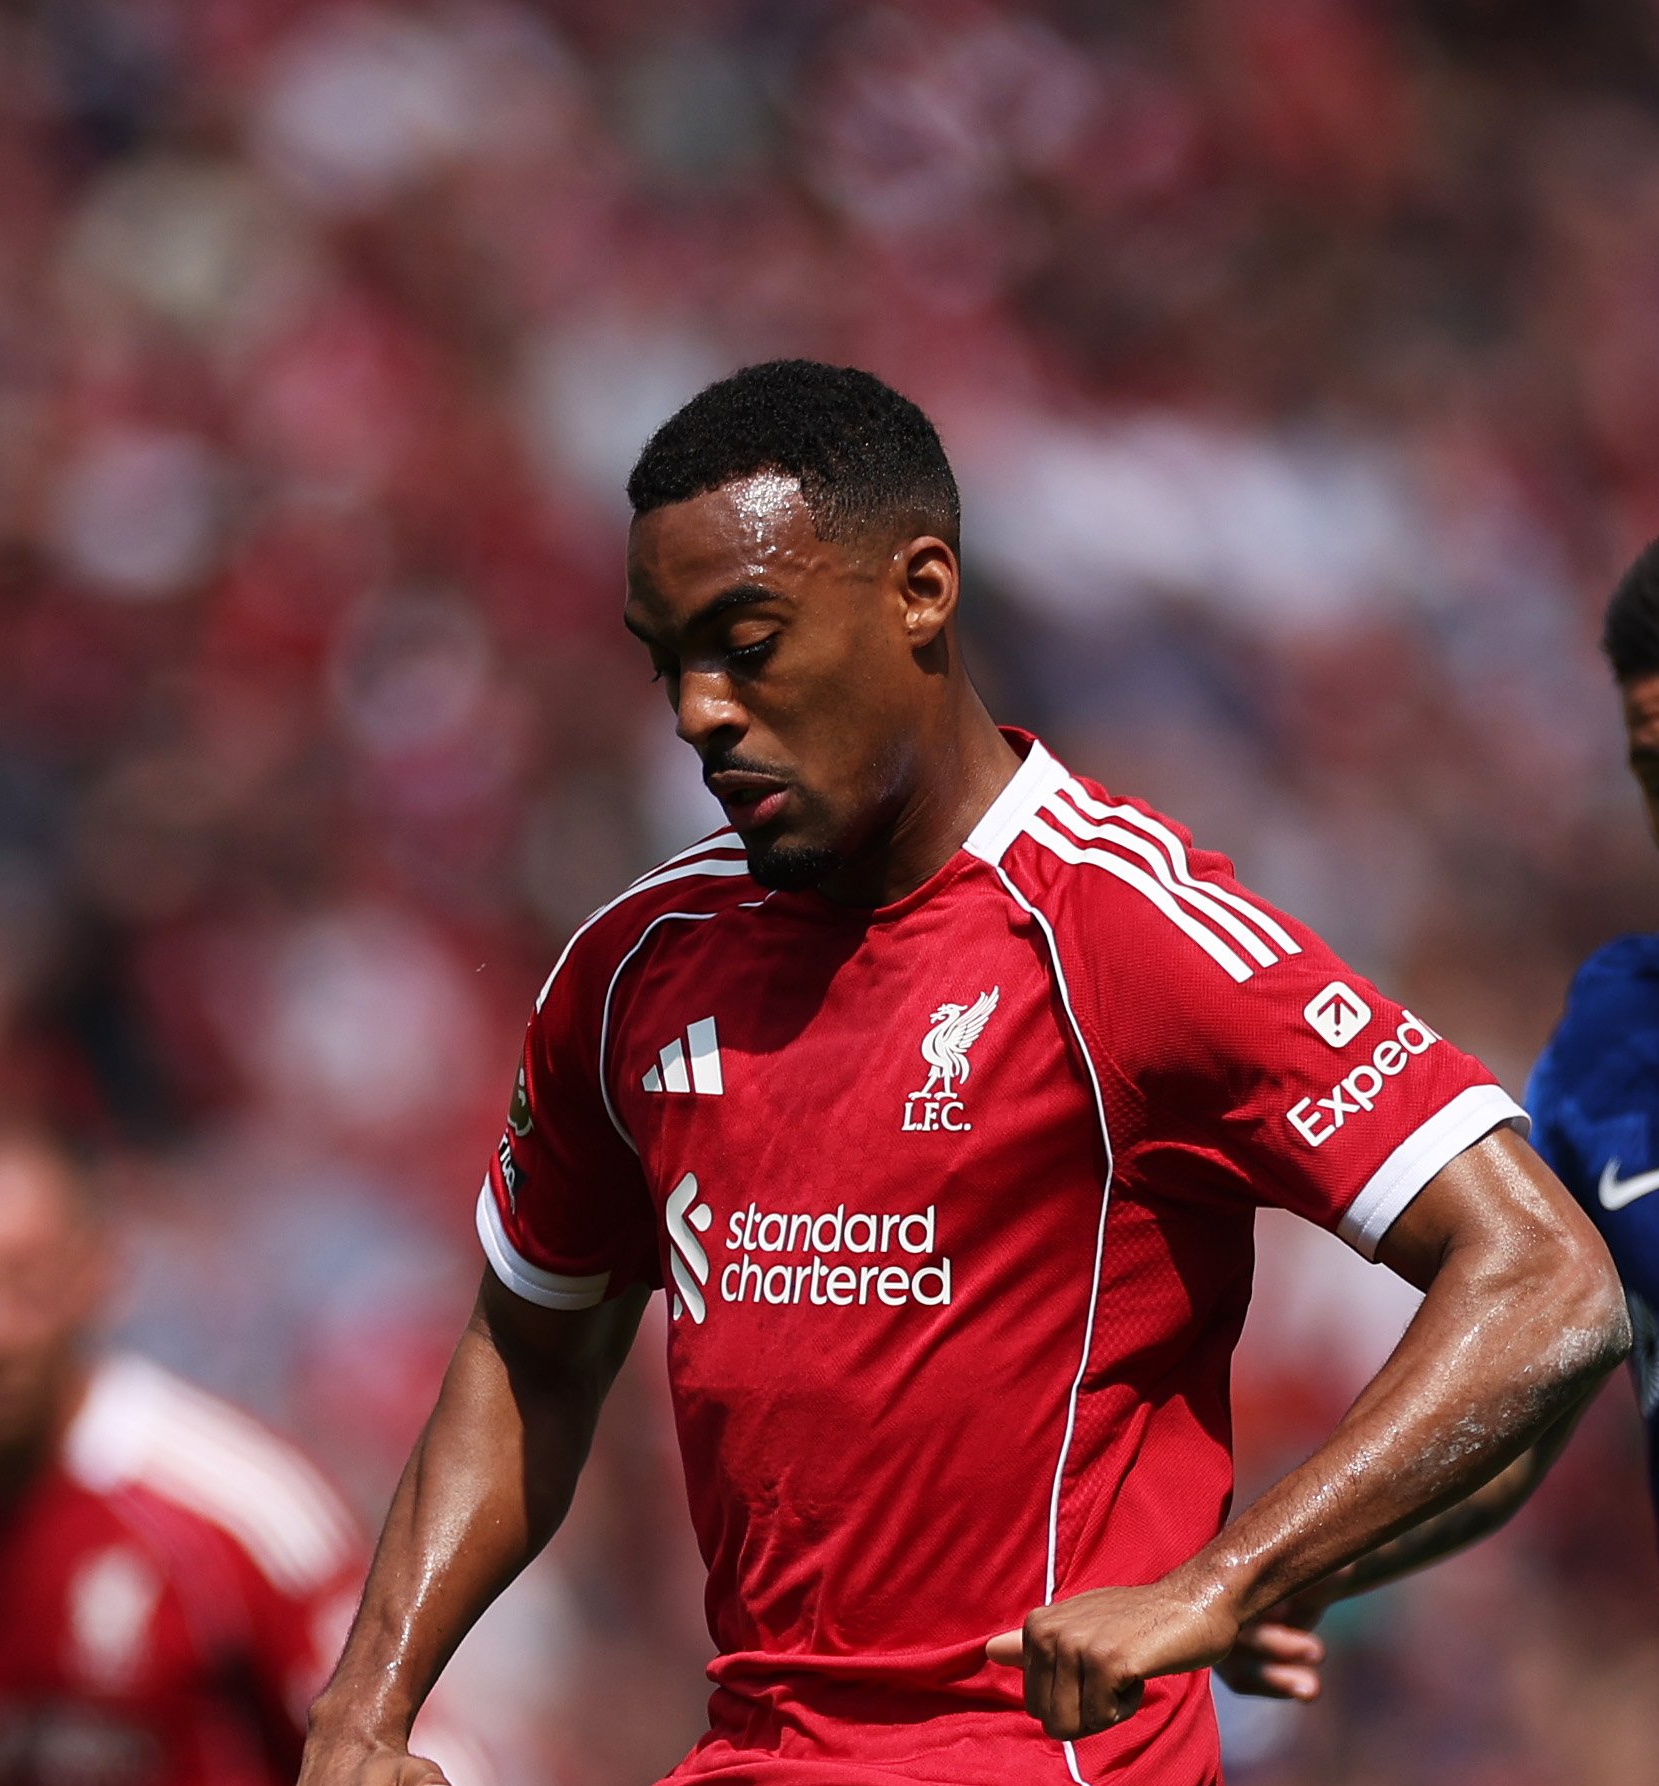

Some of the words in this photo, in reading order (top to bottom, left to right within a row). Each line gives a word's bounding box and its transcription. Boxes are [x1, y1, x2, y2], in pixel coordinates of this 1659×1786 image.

[1285, 1009, 1442, 1147] Exped
[725, 1201, 935, 1254] standard
[720, 1253, 951, 1306] chartered
